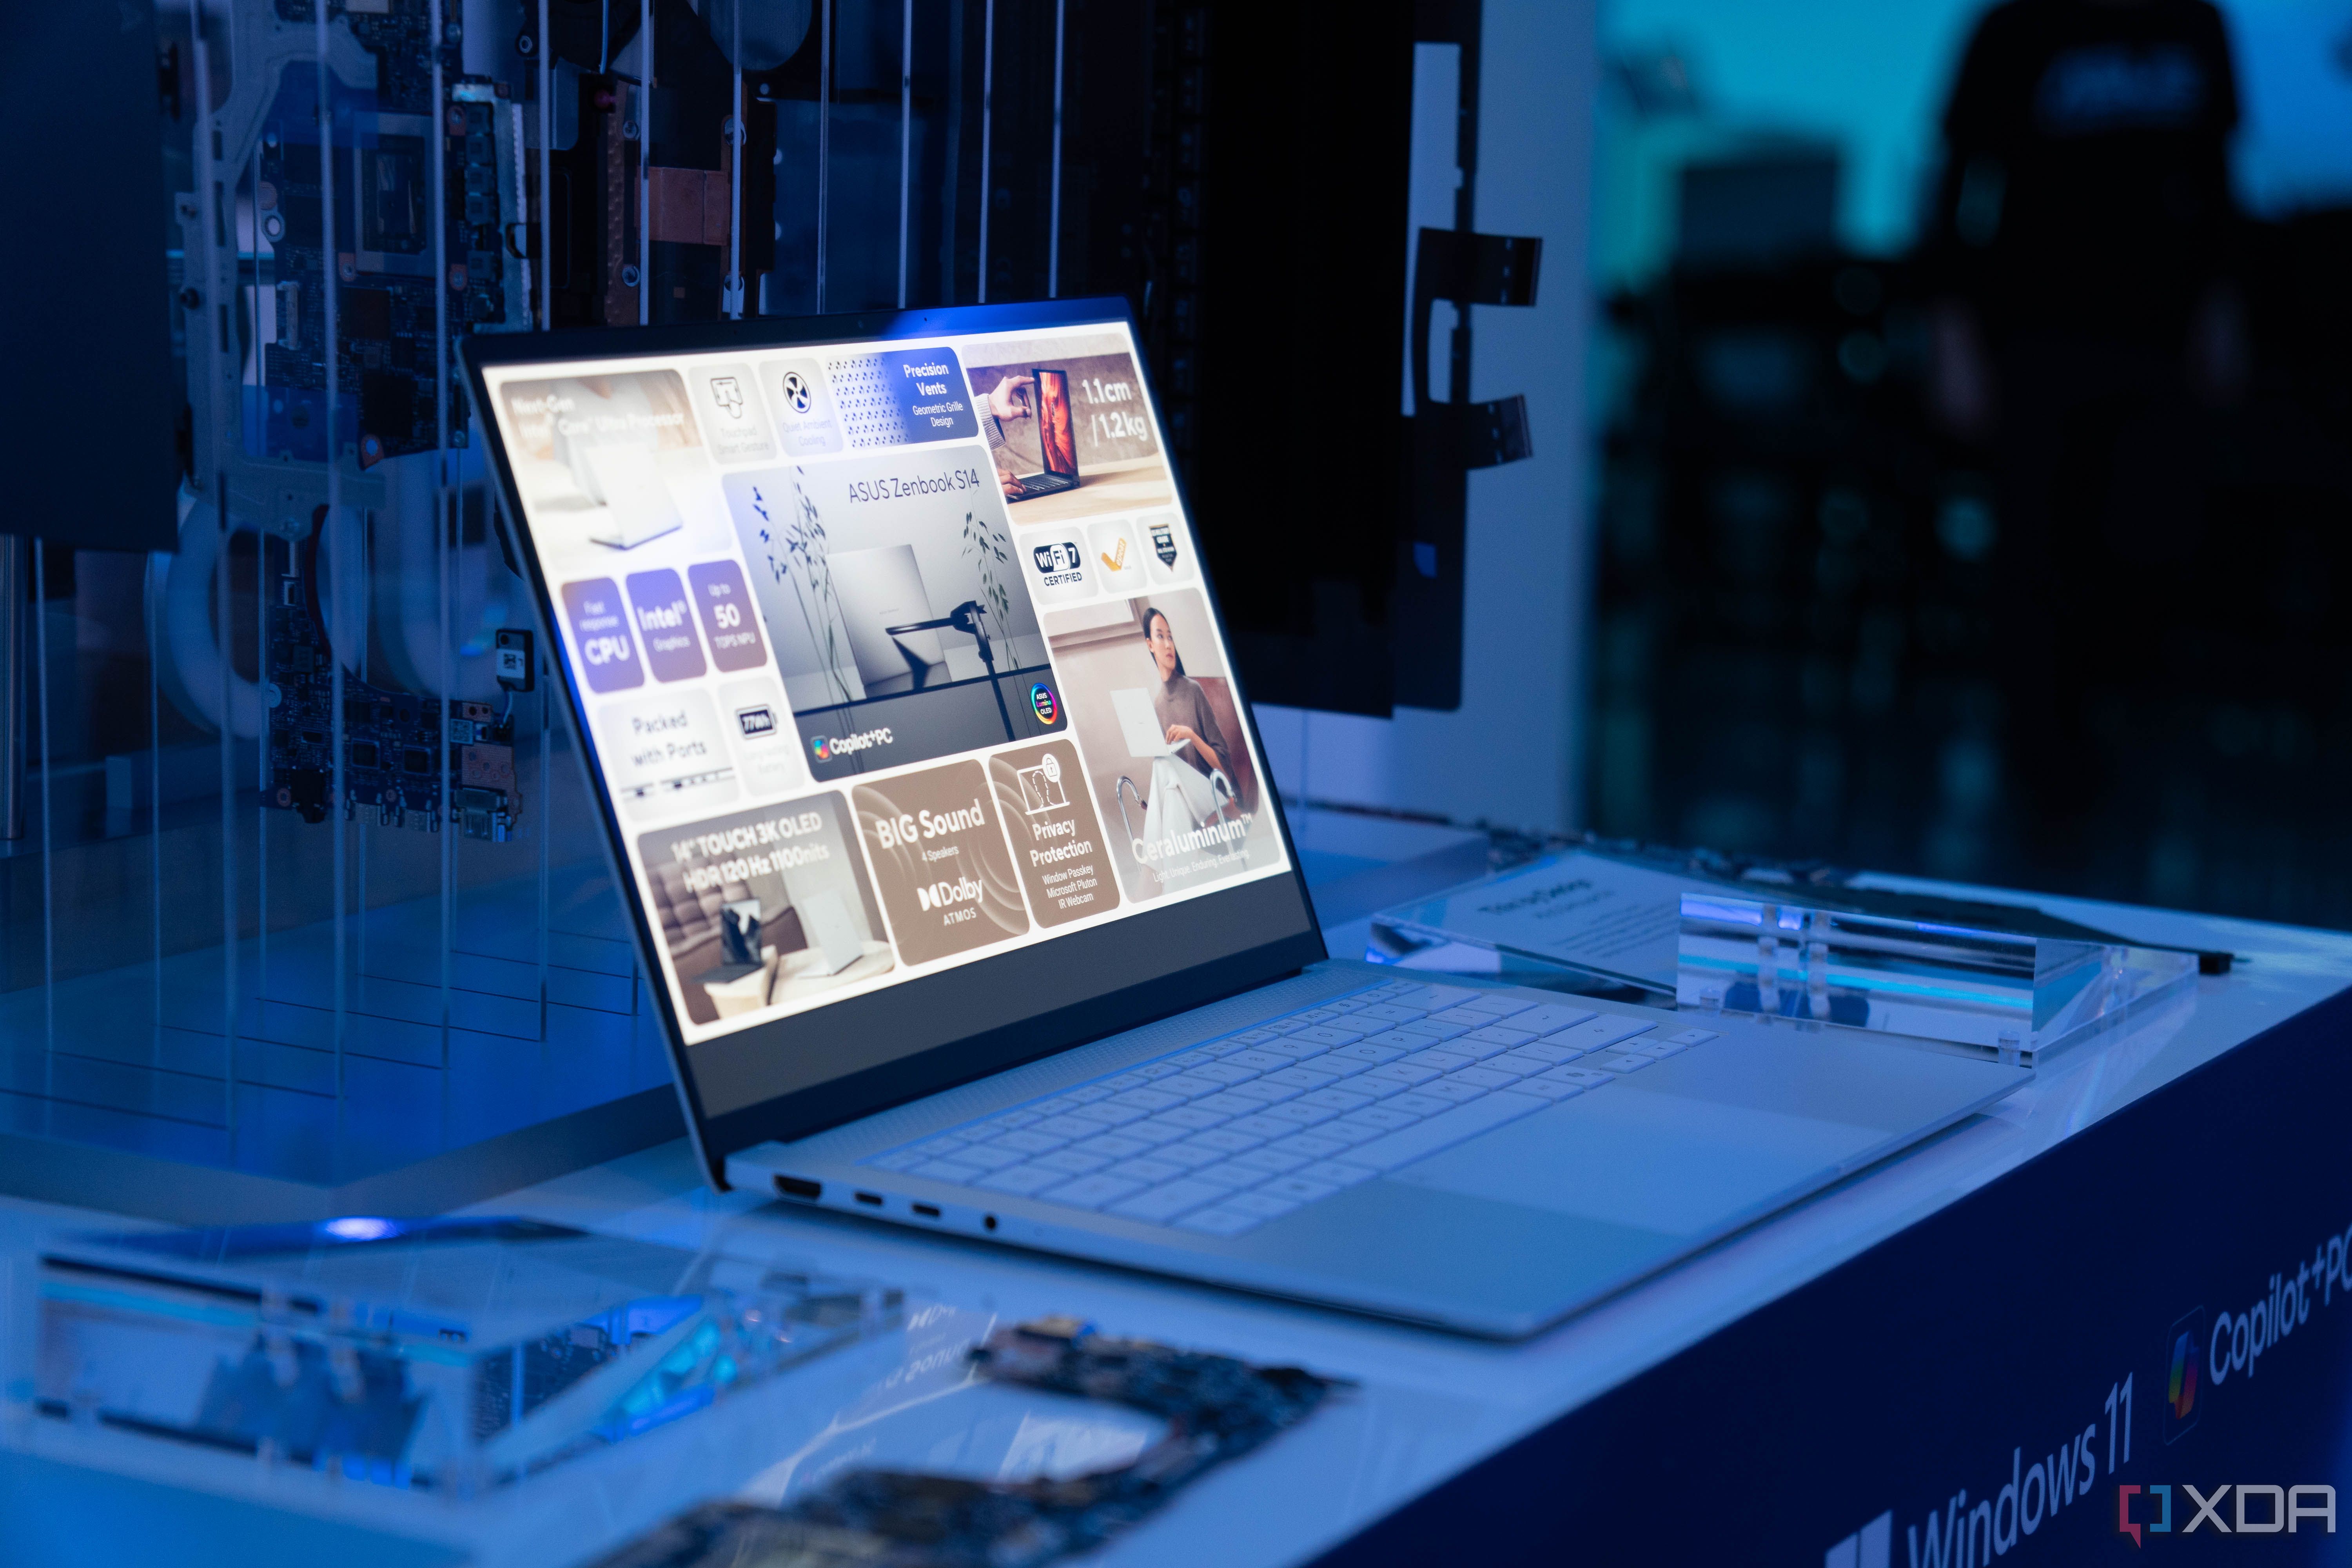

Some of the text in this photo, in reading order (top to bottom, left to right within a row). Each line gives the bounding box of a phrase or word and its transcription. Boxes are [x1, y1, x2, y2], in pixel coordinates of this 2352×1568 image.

[903, 363, 949, 378] Precision
[916, 383, 947, 396] Vents
[1082, 378, 1132, 404] 1.1cm
[913, 401, 963, 416] Geometric Grille
[931, 416, 954, 428] Design
[849, 468, 980, 504] ASUS Zenbook S14
[1068, 548, 1076, 563] 7
[1044, 572, 1082, 587] CERTIFIED
[713, 603, 741, 629] 50
[584, 635, 630, 666] CPU
[632, 710, 688, 735] Packed
[632, 741, 707, 766] with Ports
[697, 826, 758, 858] TOUCH
[758, 821, 780, 844] 3K
[779, 811, 823, 838] OLED
[875, 798, 985, 849] BIG Sound
[1032, 819, 1076, 841] Privacy
[922, 846, 960, 862] 4 Speakers
[1029, 840, 1093, 867] Protection
[682, 868, 722, 893] HDR
[721, 858, 747, 883] 120
[746, 855, 772, 877] Hz
[1042, 865, 1094, 886] Window Passkey
[938, 877, 983, 907] Dolby
[1046, 878, 1098, 898] Microsoft Pluton
[1058, 893, 1094, 909] IR Webcam
[943, 907, 977, 926] ATMOS
[1907, 1371, 2134, 1568] Windows 11
